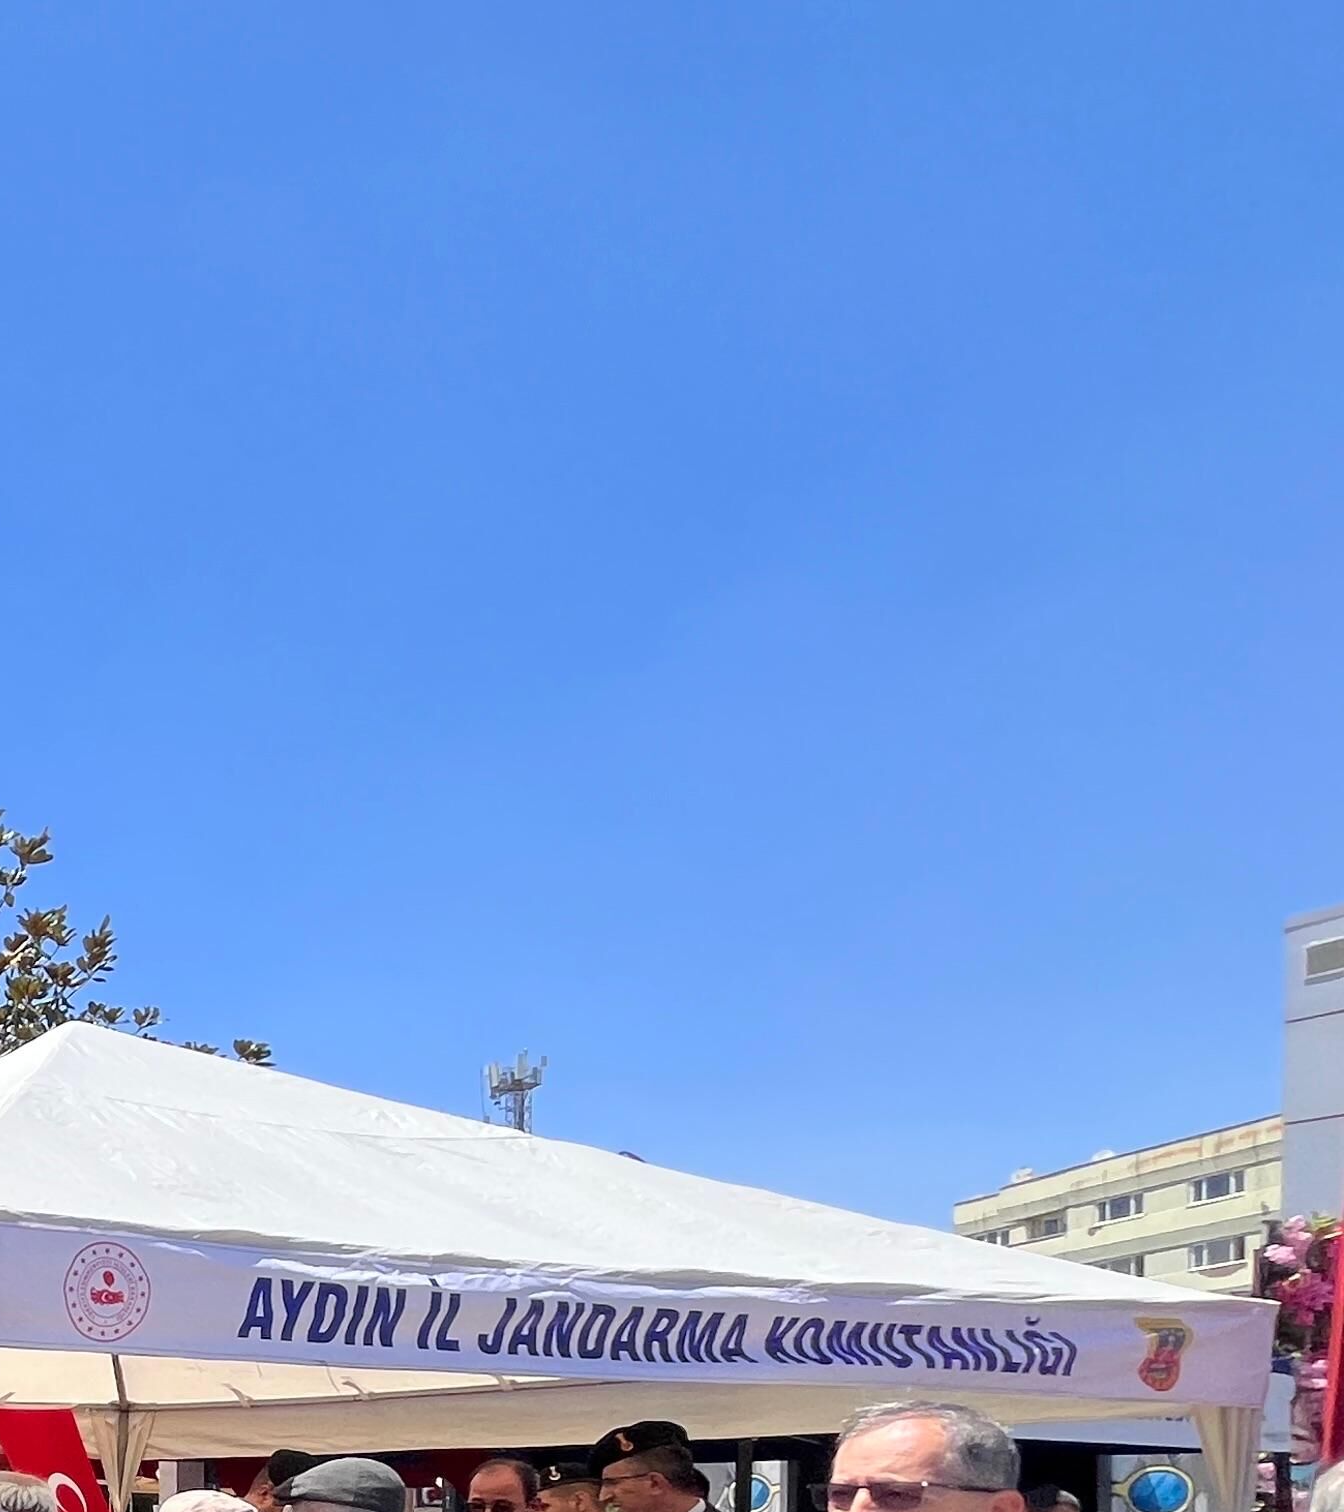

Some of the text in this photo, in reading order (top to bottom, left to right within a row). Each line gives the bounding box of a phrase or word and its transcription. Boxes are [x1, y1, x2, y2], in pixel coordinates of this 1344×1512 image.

[237, 1276, 407, 1348] AYDIN
[416, 1277, 461, 1352] İL
[477, 1297, 759, 1364] JANDARMA
[764, 1316, 1078, 1376] KOMUTANLIĞI
